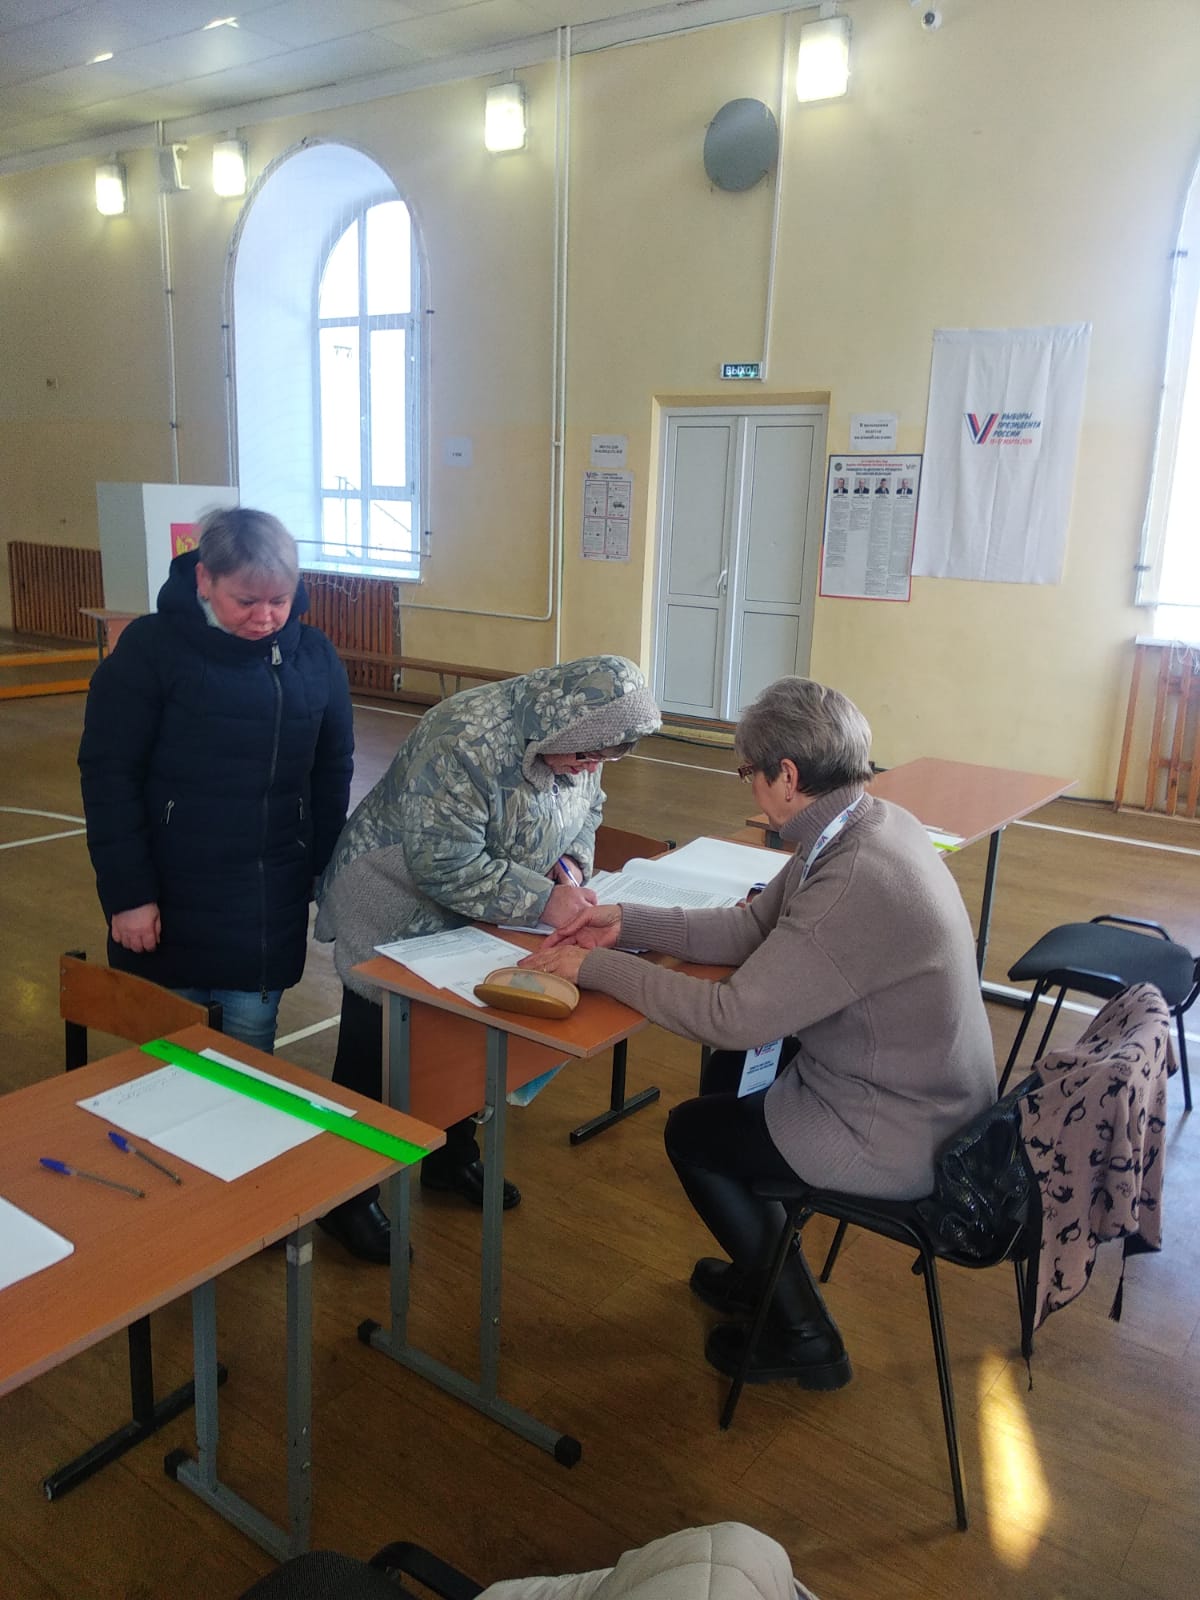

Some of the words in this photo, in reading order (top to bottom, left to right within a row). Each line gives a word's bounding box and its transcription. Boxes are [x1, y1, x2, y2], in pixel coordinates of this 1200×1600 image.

[725, 365, 758, 376] ВЫХОД
[1001, 412, 1033, 420] ВЫБОРЫ
[997, 420, 1042, 429] ПРЕЗИДЕНТА
